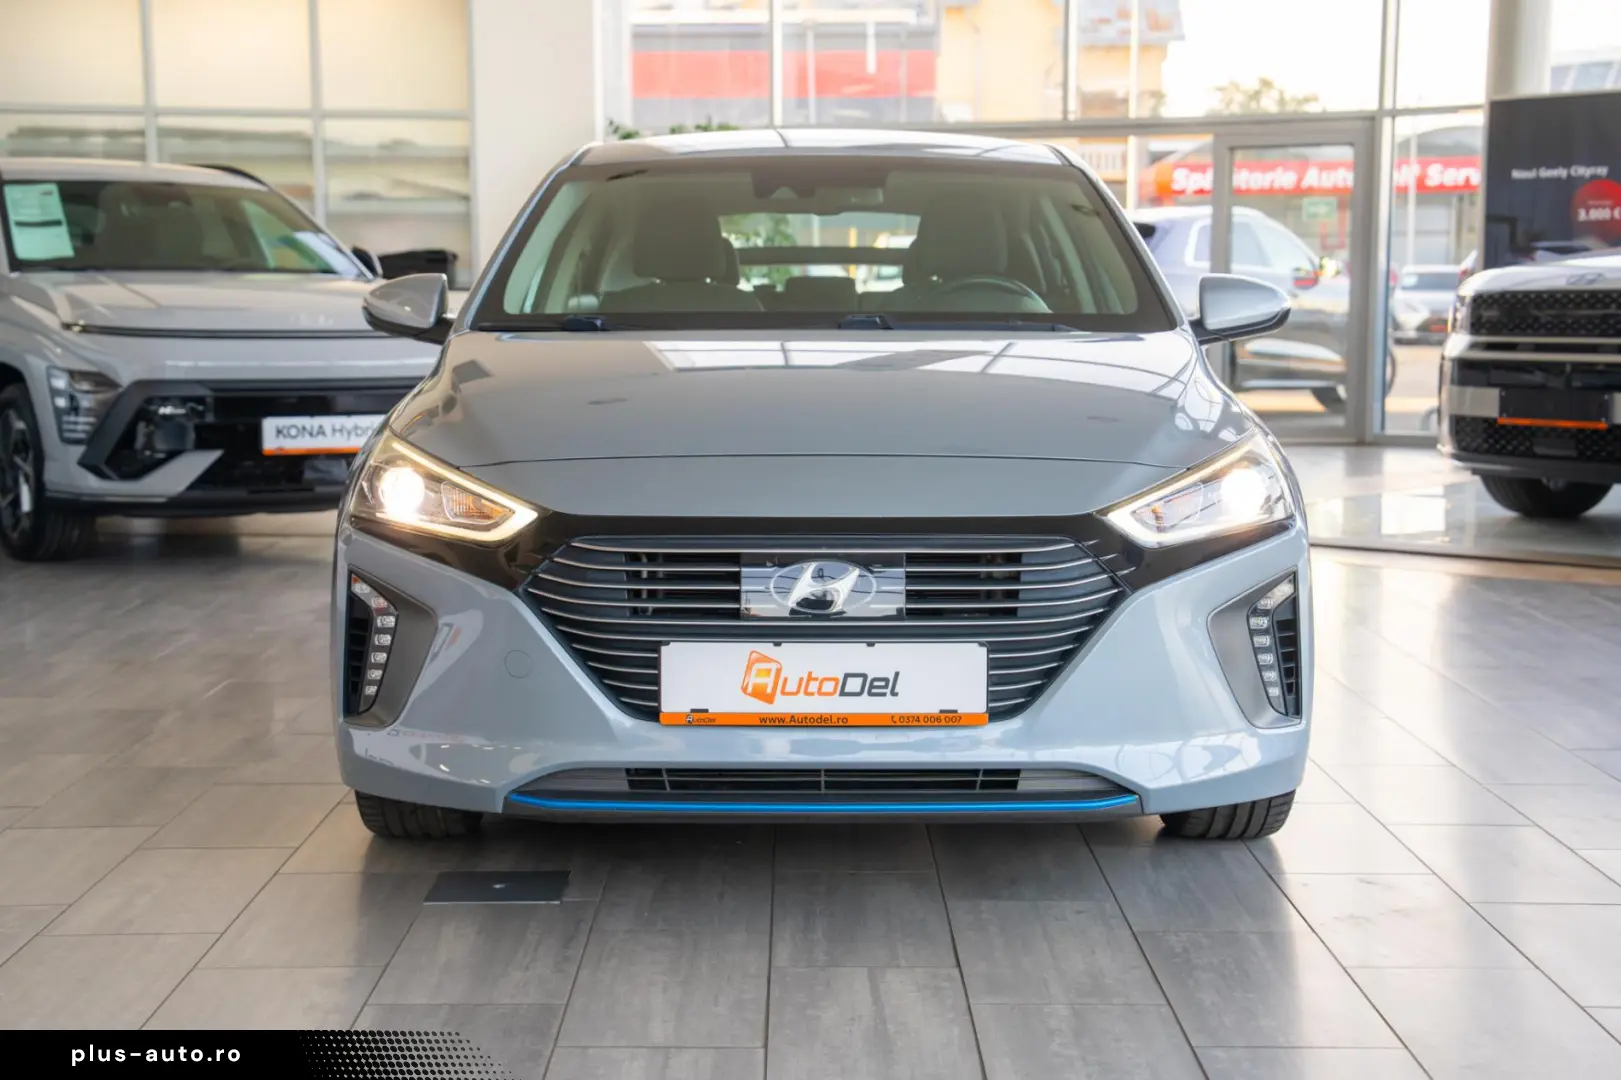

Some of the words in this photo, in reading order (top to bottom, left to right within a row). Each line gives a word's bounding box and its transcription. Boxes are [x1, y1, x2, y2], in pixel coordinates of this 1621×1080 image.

[275, 424, 327, 439] KONA
[745, 657, 900, 700] AutoDel
[759, 715, 848, 725] www.Autodel.ro
[898, 715, 921, 724] 0374
